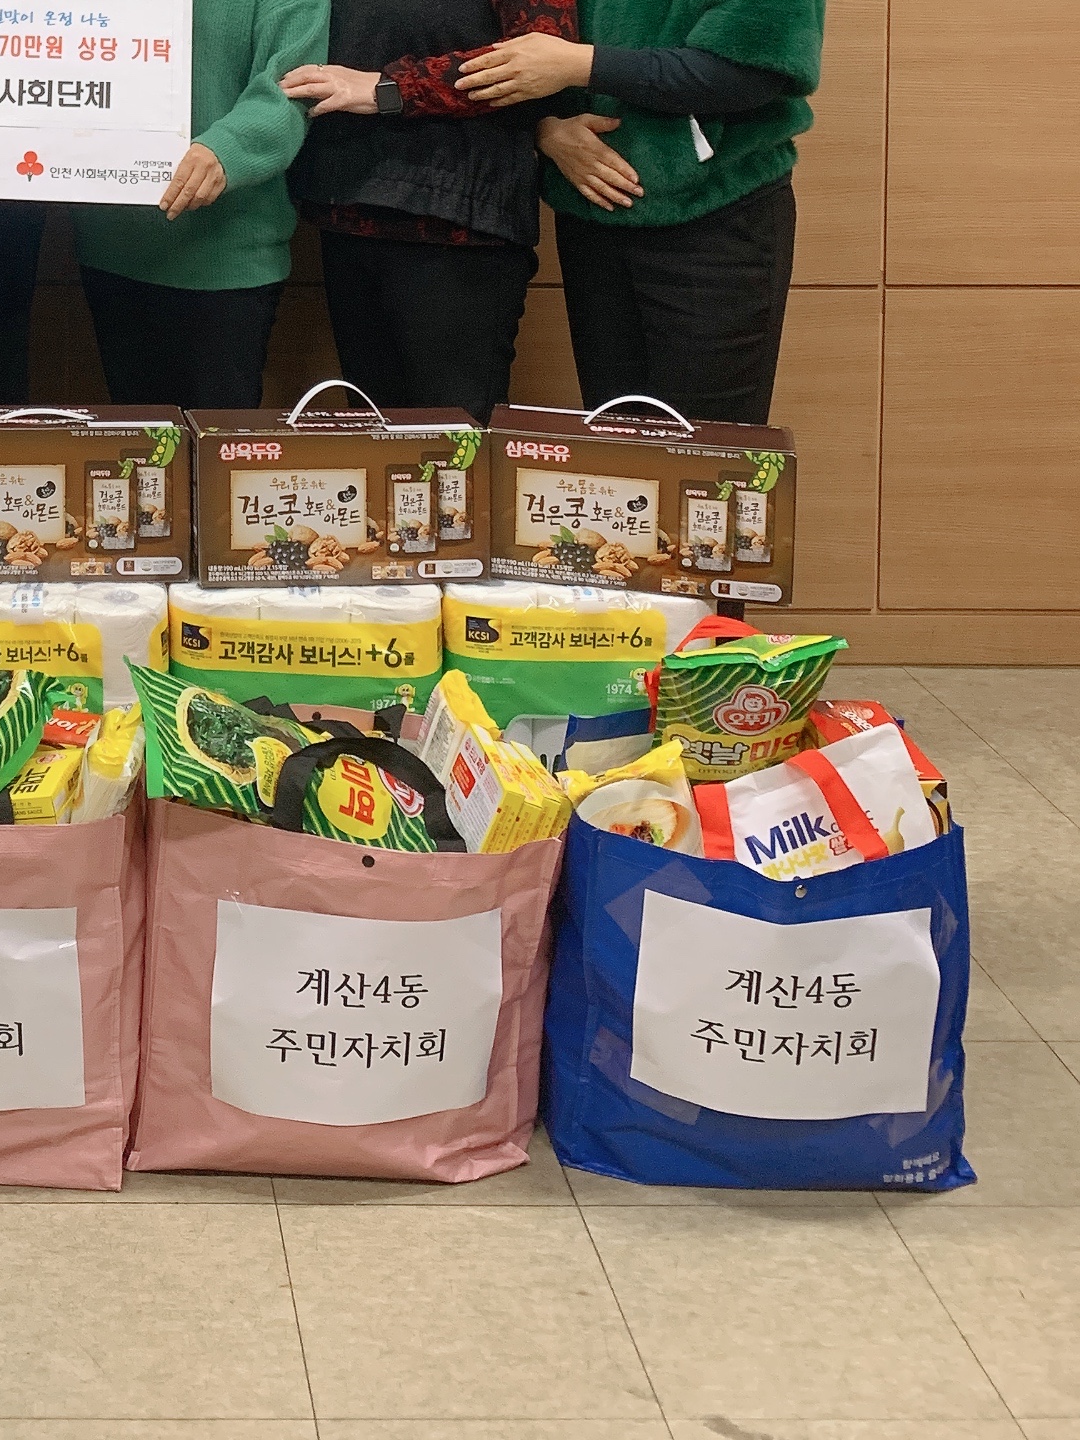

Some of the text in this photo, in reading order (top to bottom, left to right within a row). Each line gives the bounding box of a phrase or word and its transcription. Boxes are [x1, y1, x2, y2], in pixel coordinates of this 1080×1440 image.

[44, 11, 73, 26] 온정
[79, 14, 108, 28] 나눔
[77, 37, 118, 61] 상당
[132, 39, 172, 62] 기탁
[50, 167, 71, 178] 인천
[219, 442, 283, 460] 삼육두유
[505, 440, 570, 462] 삼육두유
[270, 477, 290, 491] 우리
[556, 479, 577, 492] 우리
[22, 502, 60, 522] 아몬드
[237, 494, 302, 526] 검은콩
[323, 507, 361, 526] 아몬드
[522, 493, 588, 528] 검은콩
[612, 516, 651, 535] 아몬드
[182, 637, 201, 648] KCSI
[468, 630, 490, 641] KCSI
[510, 631, 565, 648] 고객감사
[569, 633, 614, 648] 보너스!
[6, 647, 51, 664] 보너스!
[219, 640, 294, 665] 고객감사
[299, 646, 361, 668] 보너스!
[605, 684, 632, 695] 1974
[370, 698, 397, 710] 1974
[728, 712, 777, 726] 오뚜기
[745, 812, 831, 865] Milk
[297, 969, 428, 1008] 계산4동
[725, 970, 861, 1008] 계산4동
[266, 1029, 446, 1068] 주민자치회
[691, 1019, 877, 1066] 주민자치회
